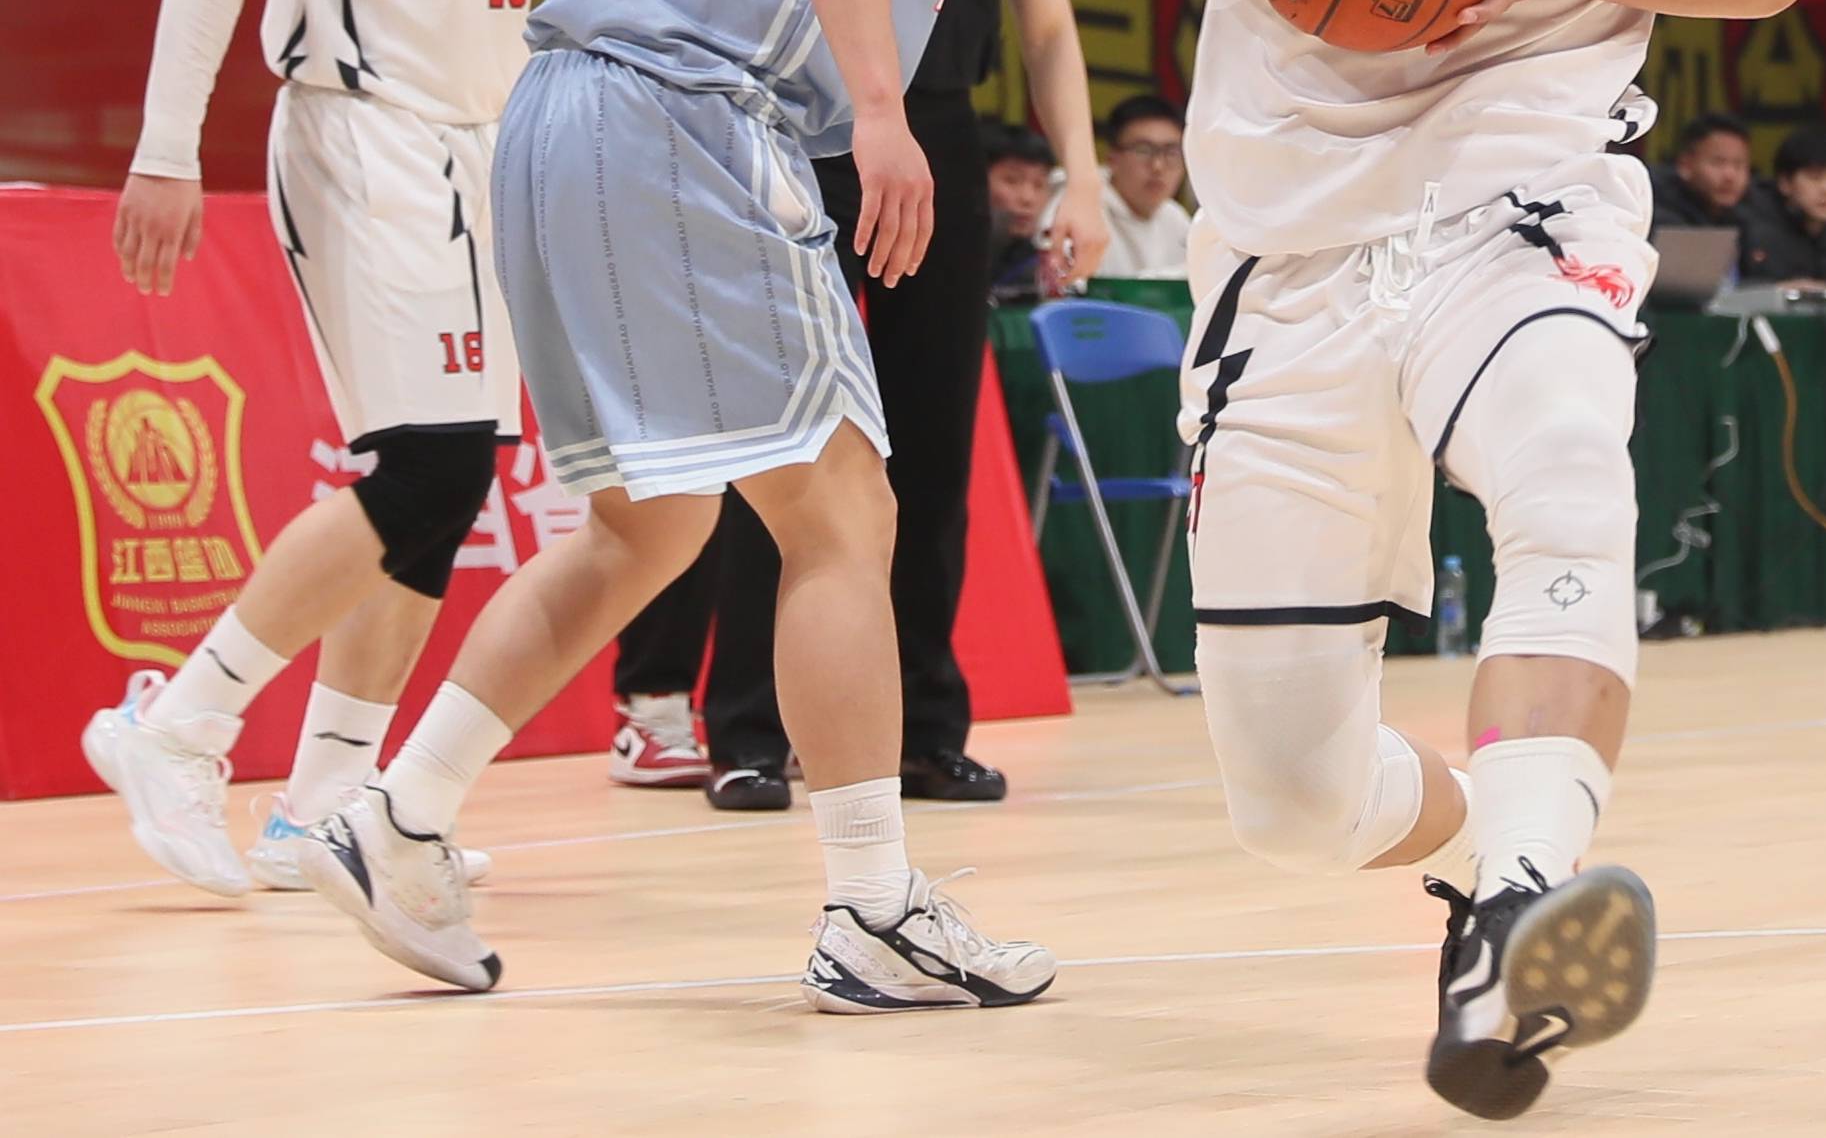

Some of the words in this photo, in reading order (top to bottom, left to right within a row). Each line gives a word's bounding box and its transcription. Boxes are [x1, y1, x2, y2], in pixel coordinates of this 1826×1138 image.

[594, 137, 606, 197] SHANGRAO
[669, 161, 684, 218] SHANGRAO
[597, 200, 615, 259] SHANGRAO
[677, 221, 694, 279] SHANGRAO
[607, 261, 625, 320] SHANGRAO
[758, 245, 776, 302] SHANGRAO
[687, 282, 705, 339] SHANGRAO
[768, 304, 787, 359] SHANGRAO
[617, 323, 638, 381] SHANGRAO
[698, 342, 718, 398] SHANGRAO
[631, 384, 649, 440] SHANGRAO
